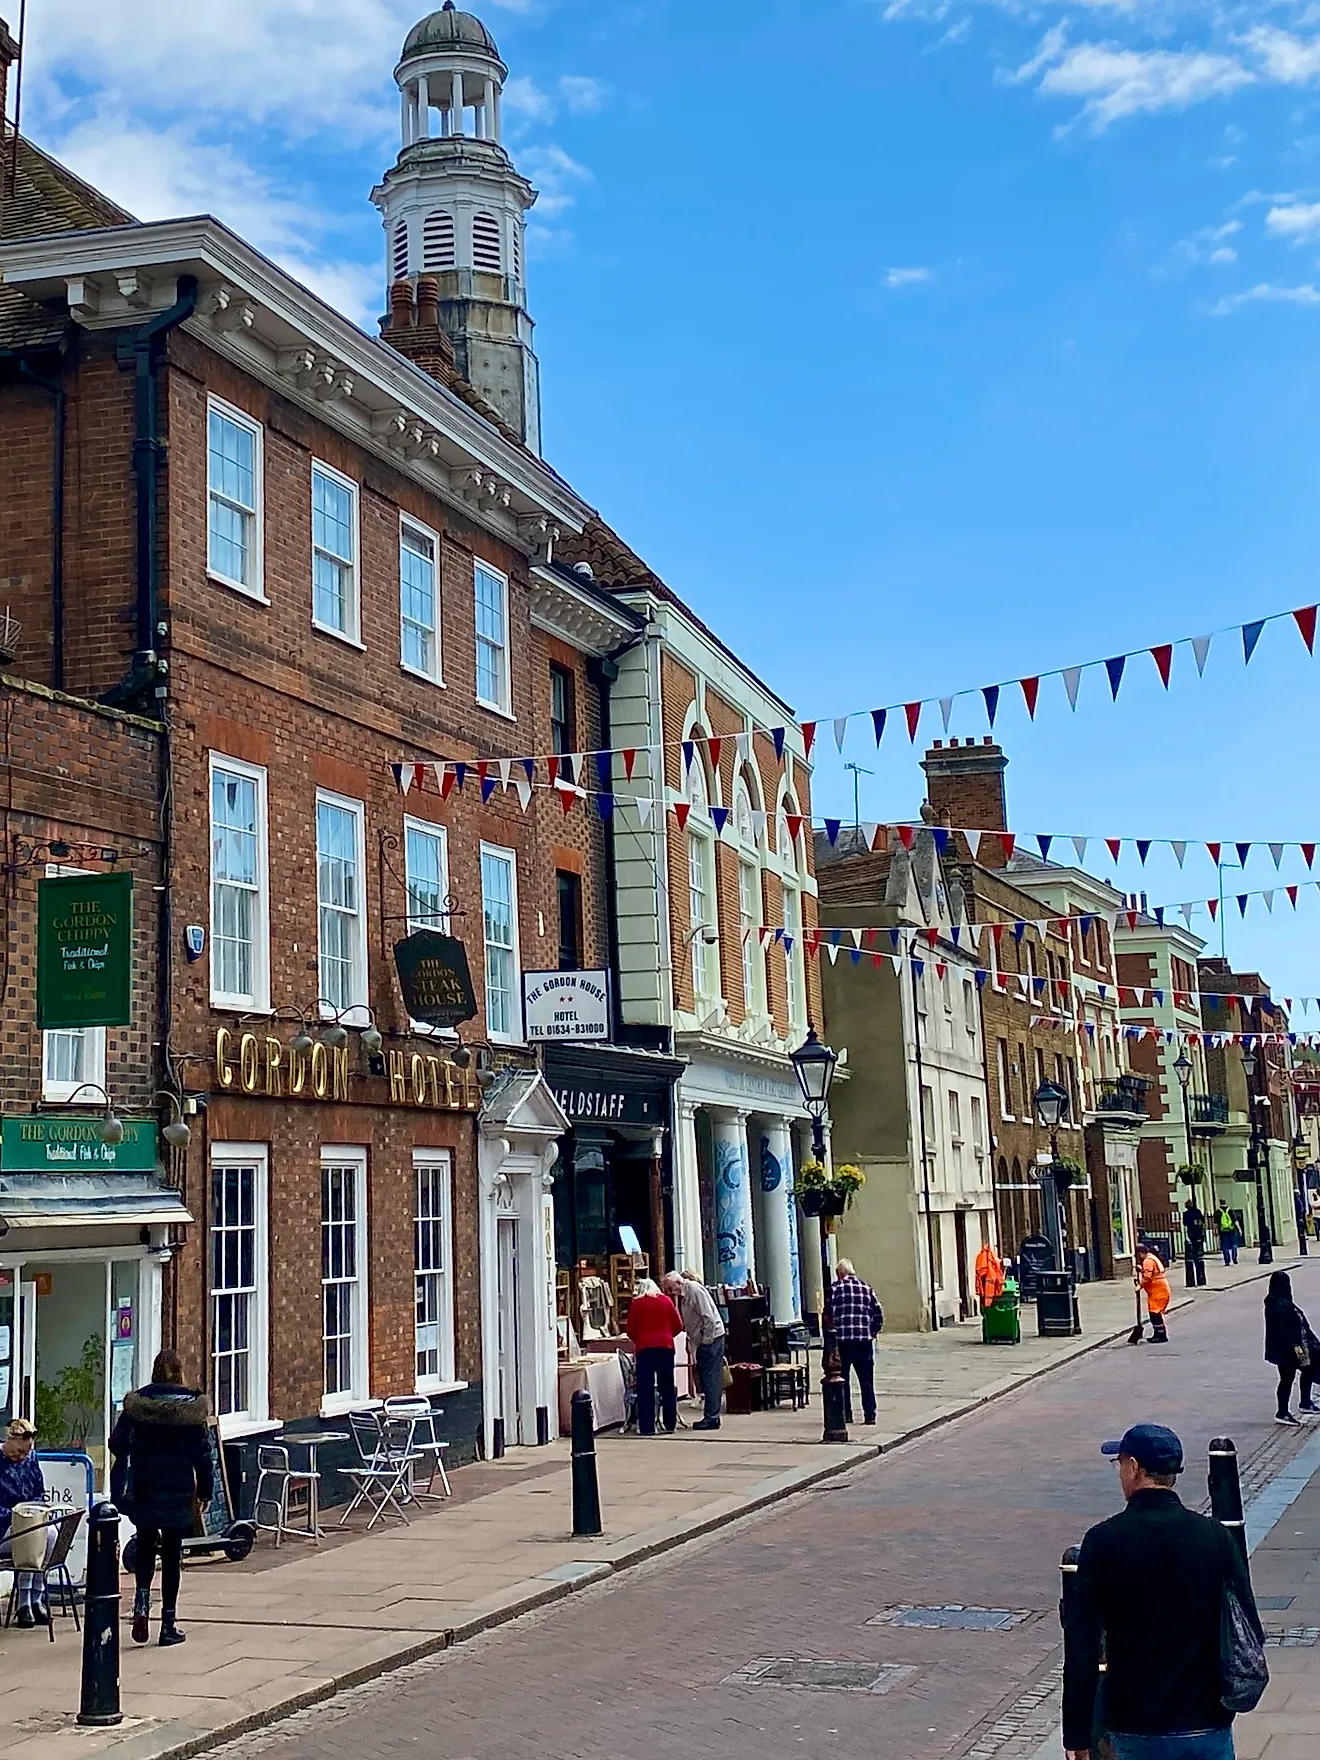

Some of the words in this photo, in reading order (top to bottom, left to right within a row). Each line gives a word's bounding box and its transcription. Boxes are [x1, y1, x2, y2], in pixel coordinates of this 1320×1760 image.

[69, 900, 101, 914] THE
[53, 913, 117, 929] GORDON
[410, 978, 462, 992] STEAK
[526, 986, 543, 1004] THE
[543, 976, 577, 992] GORDON
[579, 979, 607, 1003] HOUSE
[412, 992, 468, 1007] HOUSE
[554, 1011, 579, 1022] HOTEL
[530, 1026, 544, 1036] TEL
[546, 1023, 605, 1036] 01634-831000
[216, 1027, 349, 1101] GORDON
[389, 1049, 475, 1109] HOTEL
[20, 1124, 45, 1141] THE
[48, 1124, 98, 1142] GORDON
[41, 1485, 61, 1503] sh
[61, 1487, 74, 1503] &
